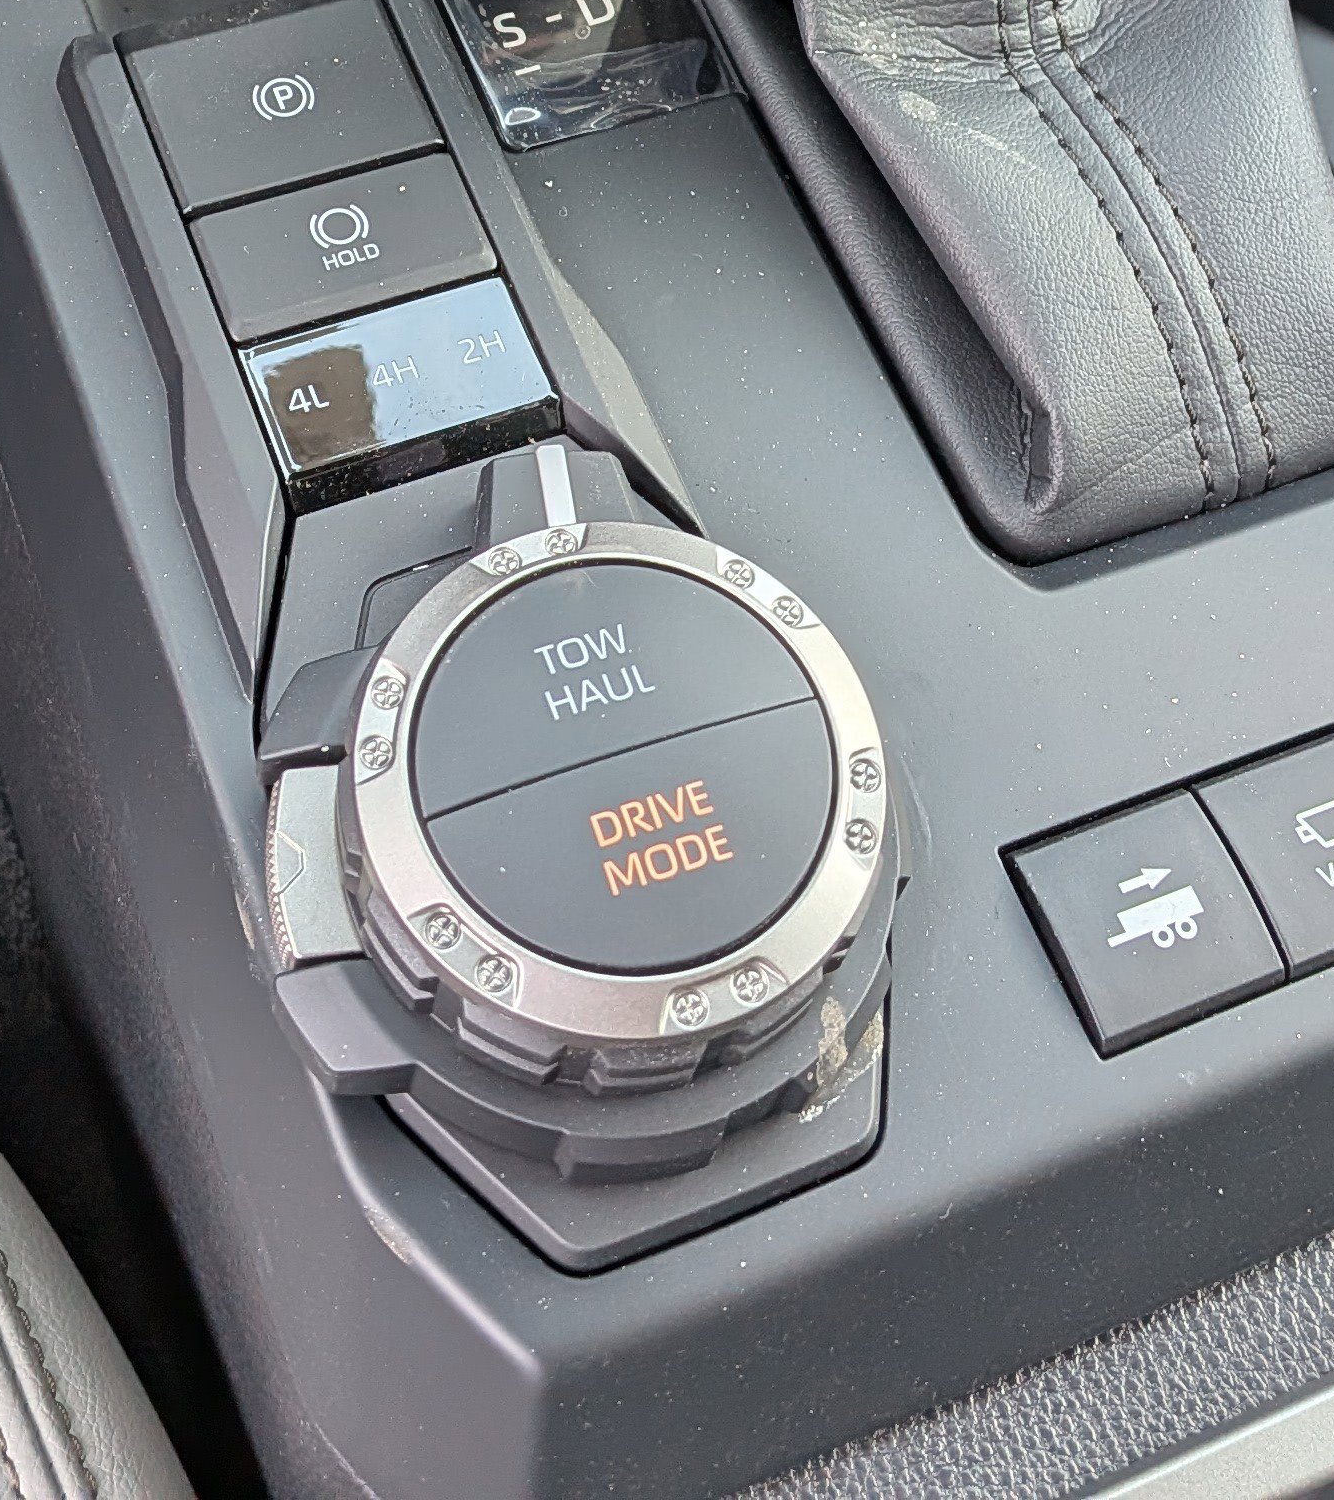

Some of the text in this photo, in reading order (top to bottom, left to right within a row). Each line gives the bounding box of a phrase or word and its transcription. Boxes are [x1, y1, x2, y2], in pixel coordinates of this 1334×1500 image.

[494, 11, 527, 50] S
[272, 84, 293, 110] P
[322, 242, 380, 271] HOLD
[287, 329, 508, 415] 4L 4H 2H
[533, 622, 627, 675] TOW
[544, 663, 656, 721] HAUL
[589, 779, 715, 848] DRIVE
[601, 824, 735, 898] MODE
